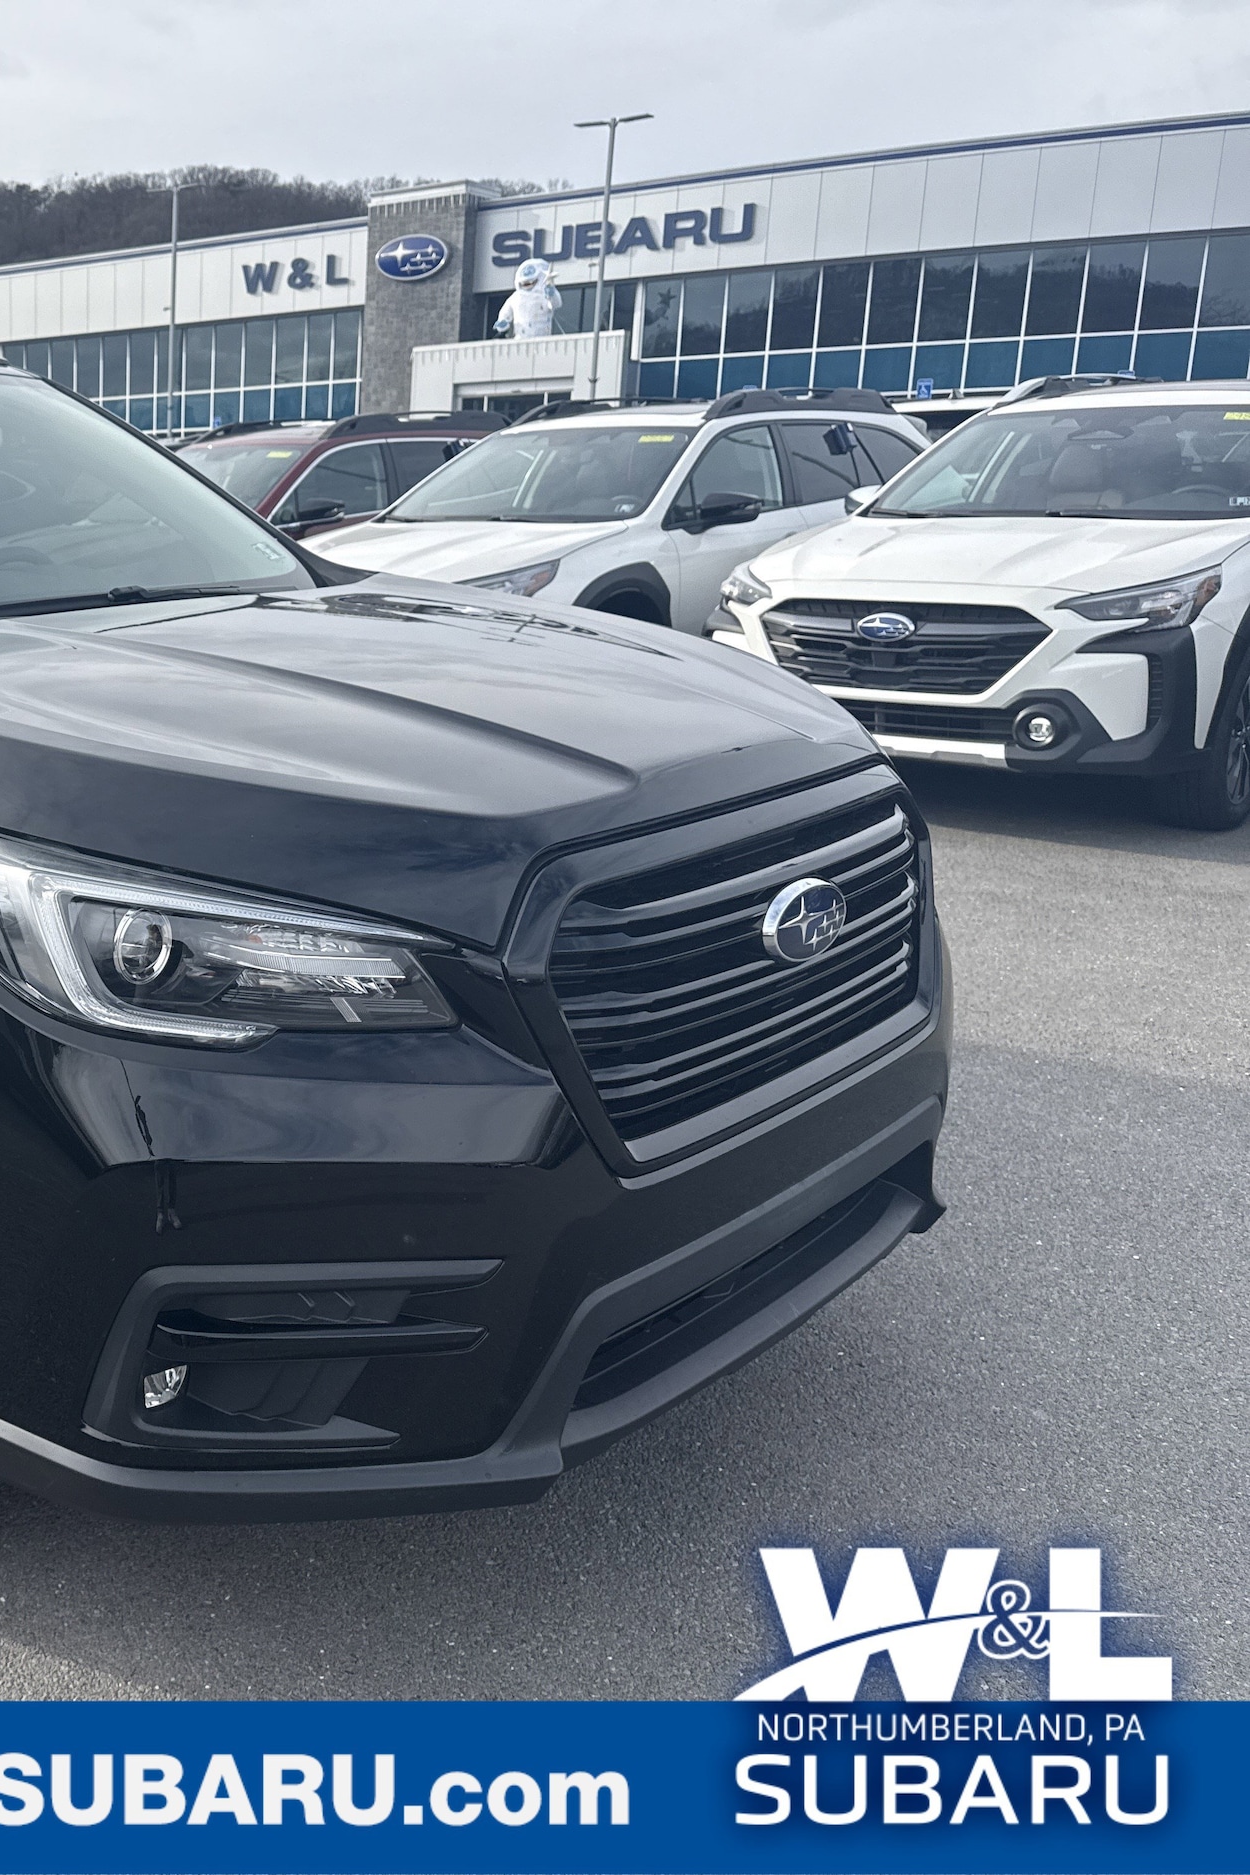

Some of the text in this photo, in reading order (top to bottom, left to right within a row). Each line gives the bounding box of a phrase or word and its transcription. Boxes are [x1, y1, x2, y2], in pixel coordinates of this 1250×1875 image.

[492, 203, 757, 267] SUBARU
[242, 254, 350, 295] W & L
